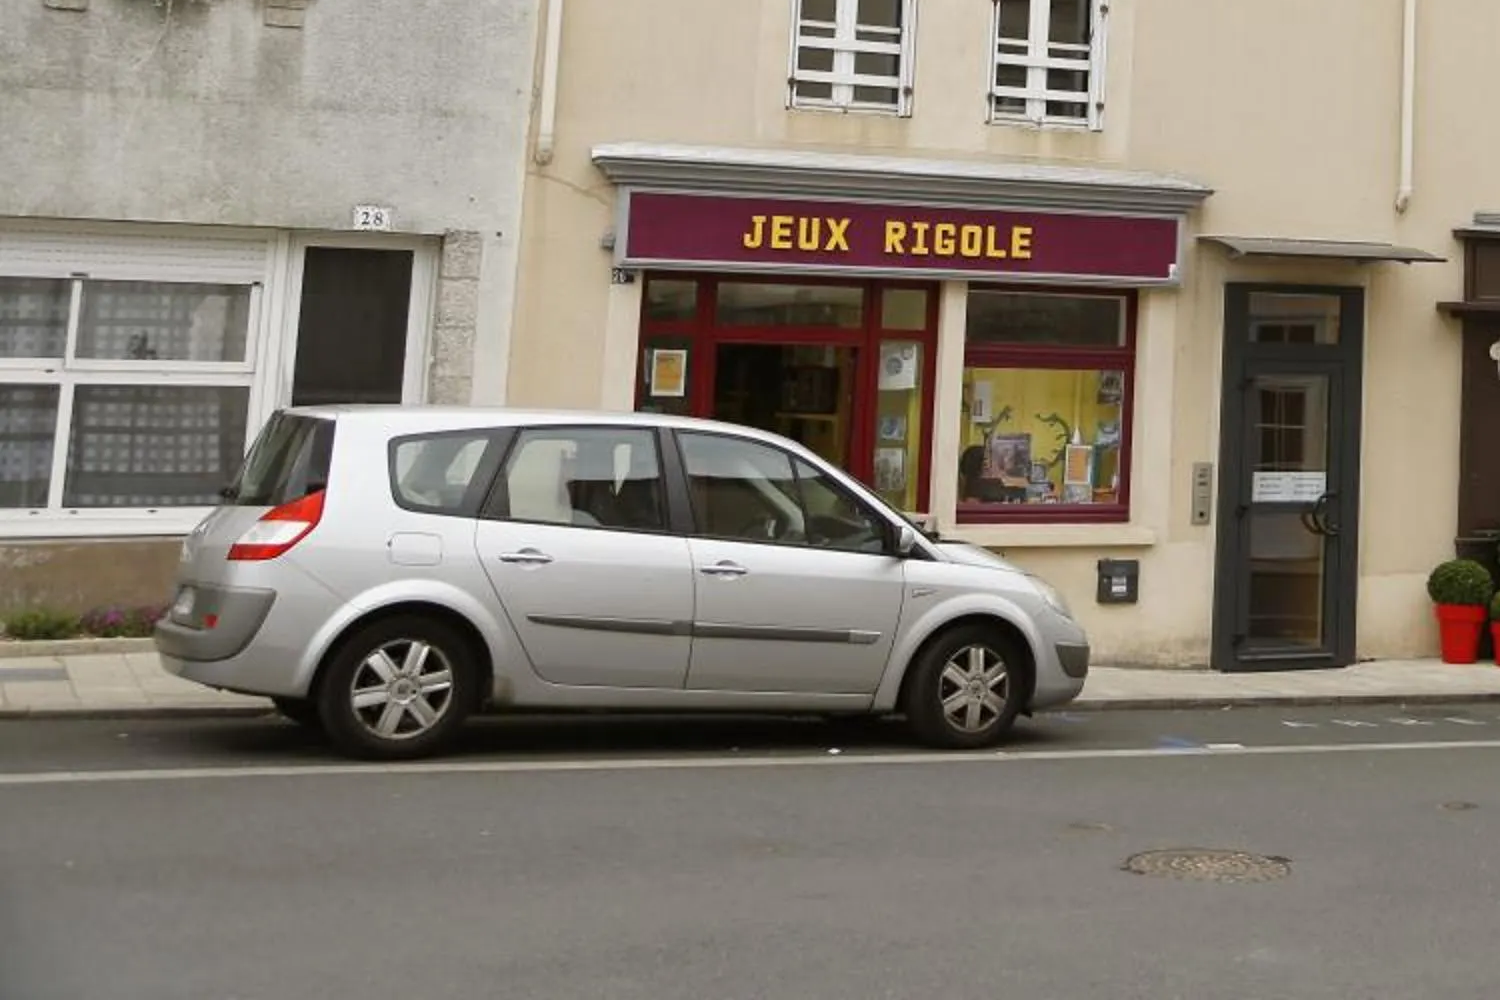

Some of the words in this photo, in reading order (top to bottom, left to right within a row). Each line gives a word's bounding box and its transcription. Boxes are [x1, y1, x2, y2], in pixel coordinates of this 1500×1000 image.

[361, 211, 384, 226] 28
[743, 215, 850, 251] JEUX
[884, 219, 1033, 259] RIGOLE
